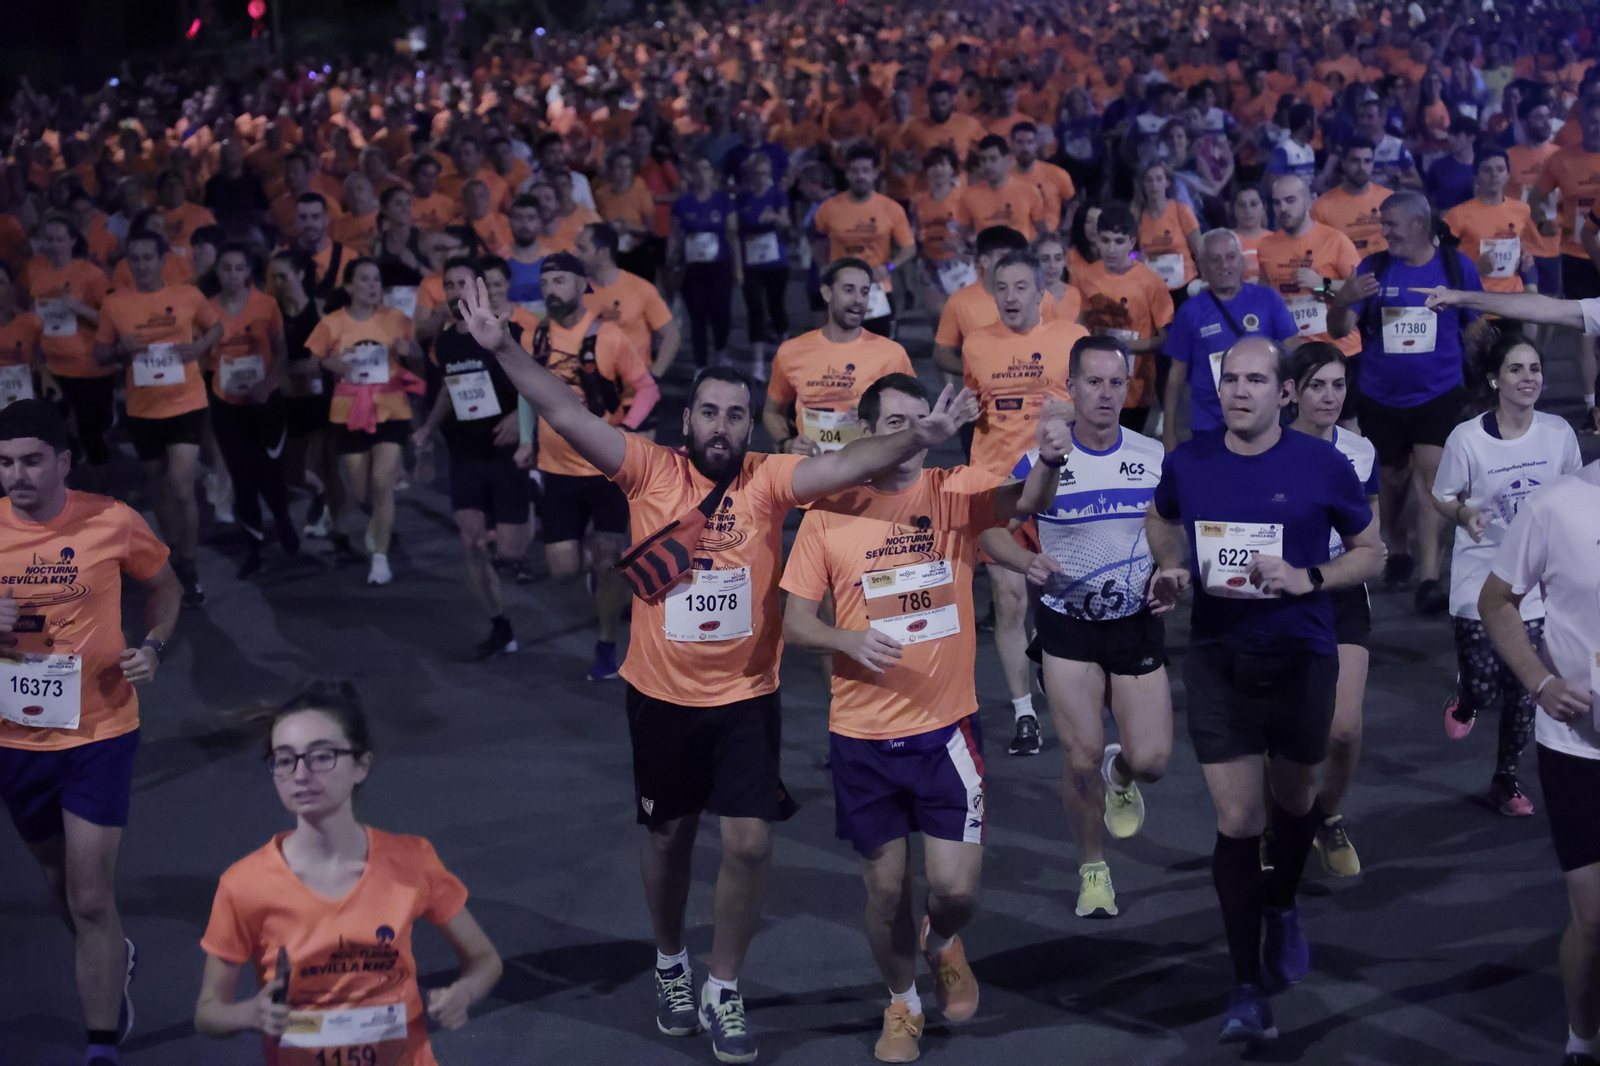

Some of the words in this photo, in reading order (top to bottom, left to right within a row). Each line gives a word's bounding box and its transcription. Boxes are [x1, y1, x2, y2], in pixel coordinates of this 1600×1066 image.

[1291, 307, 1318, 320] 9768
[1394, 322, 1426, 334] 17380
[820, 430, 842, 443] 204
[1119, 461, 1145, 476] ACS
[886, 534, 934, 545] NOCTURNA
[865, 546, 907, 559] SEVILLA
[1218, 548, 1259, 567] 622
[25, 566, 78, 574] NOCTURNA
[1, 575, 48, 584] SEVILLA
[685, 593, 738, 612] 13078
[898, 590, 932, 613] 786
[10, 676, 63, 697] 16373
[300, 962, 360, 977] SEVILLA
[315, 1045, 377, 1066] 1159
